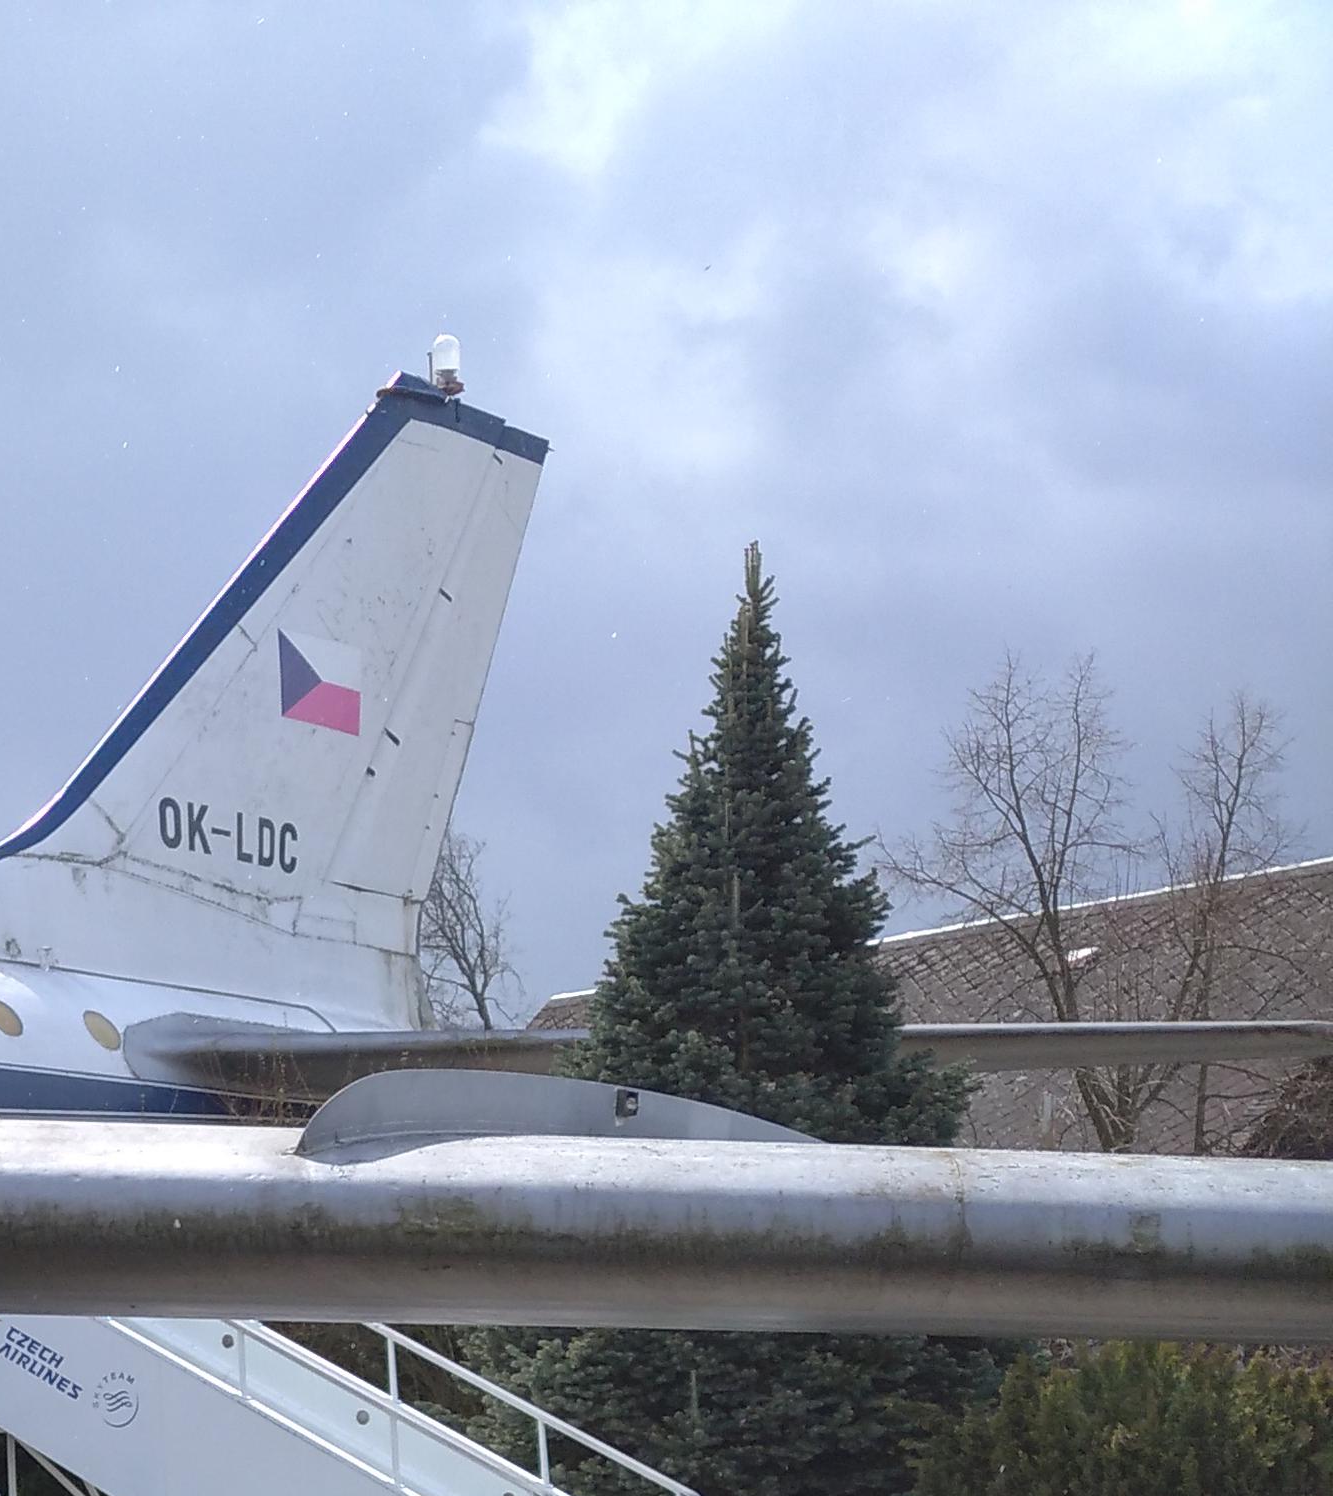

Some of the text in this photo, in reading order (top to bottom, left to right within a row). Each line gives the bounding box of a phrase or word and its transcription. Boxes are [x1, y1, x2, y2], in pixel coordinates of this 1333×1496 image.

[157, 796, 299, 875] OK-LDC
[5, 1326, 64, 1369] CZECH
[92, 1371, 135, 1409] SKYTEAM
